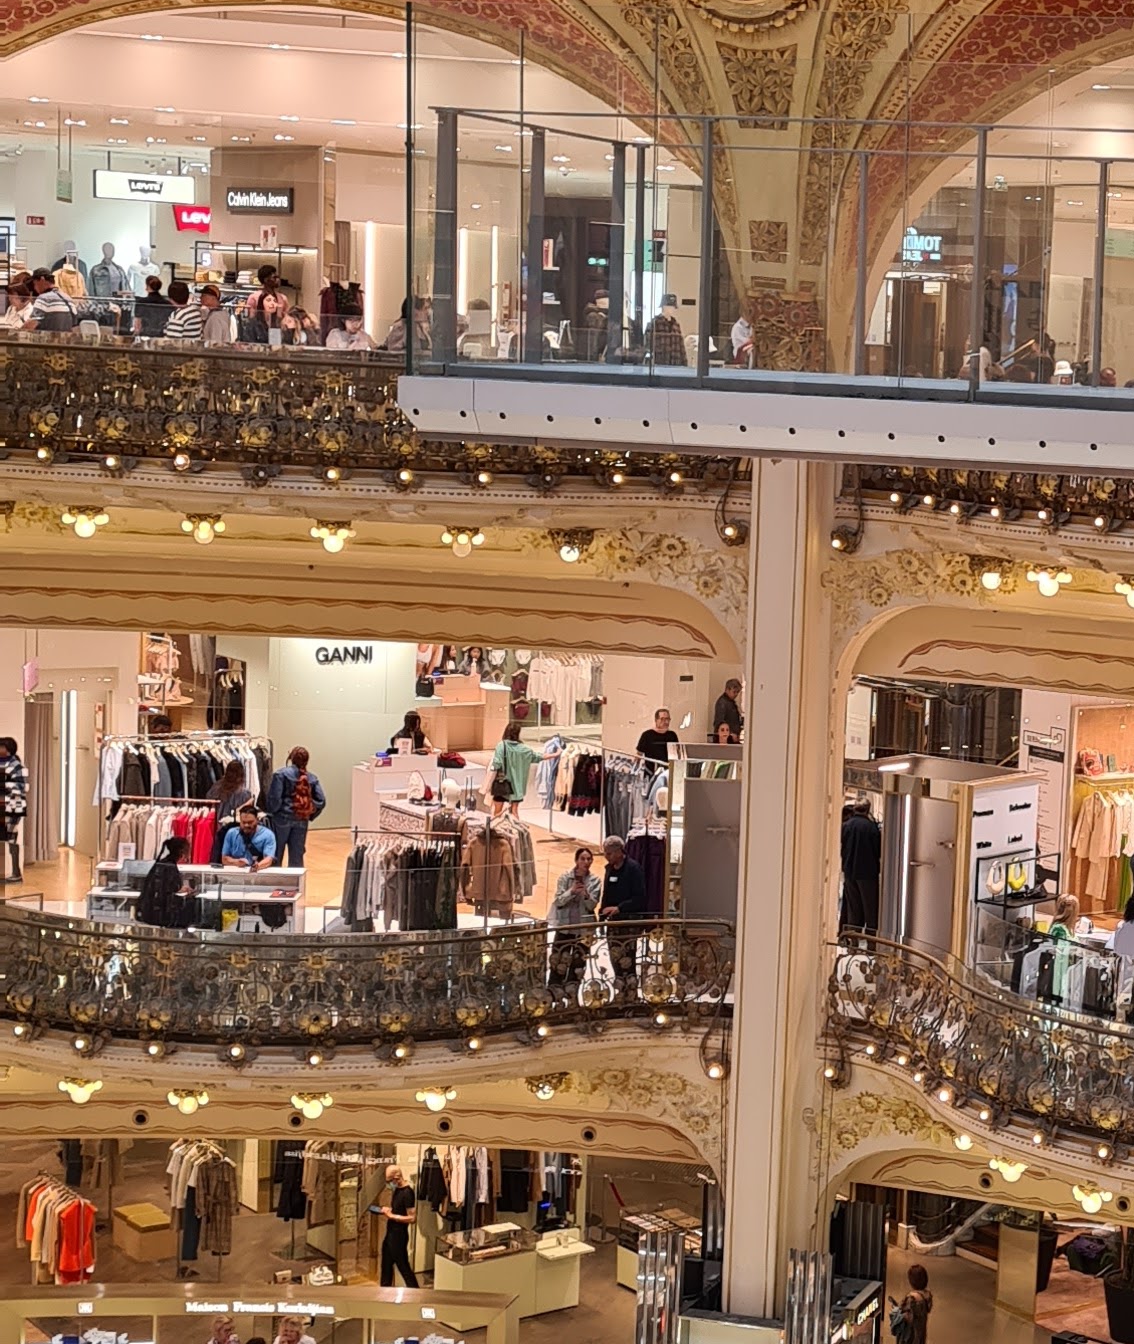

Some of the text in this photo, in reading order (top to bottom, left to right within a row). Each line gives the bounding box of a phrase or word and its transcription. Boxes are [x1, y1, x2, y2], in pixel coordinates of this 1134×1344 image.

[228, 192, 288, 207] Calvin Klein Jeans
[315, 646, 373, 665] GANNI
[185, 1302, 229, 1312] Maison
